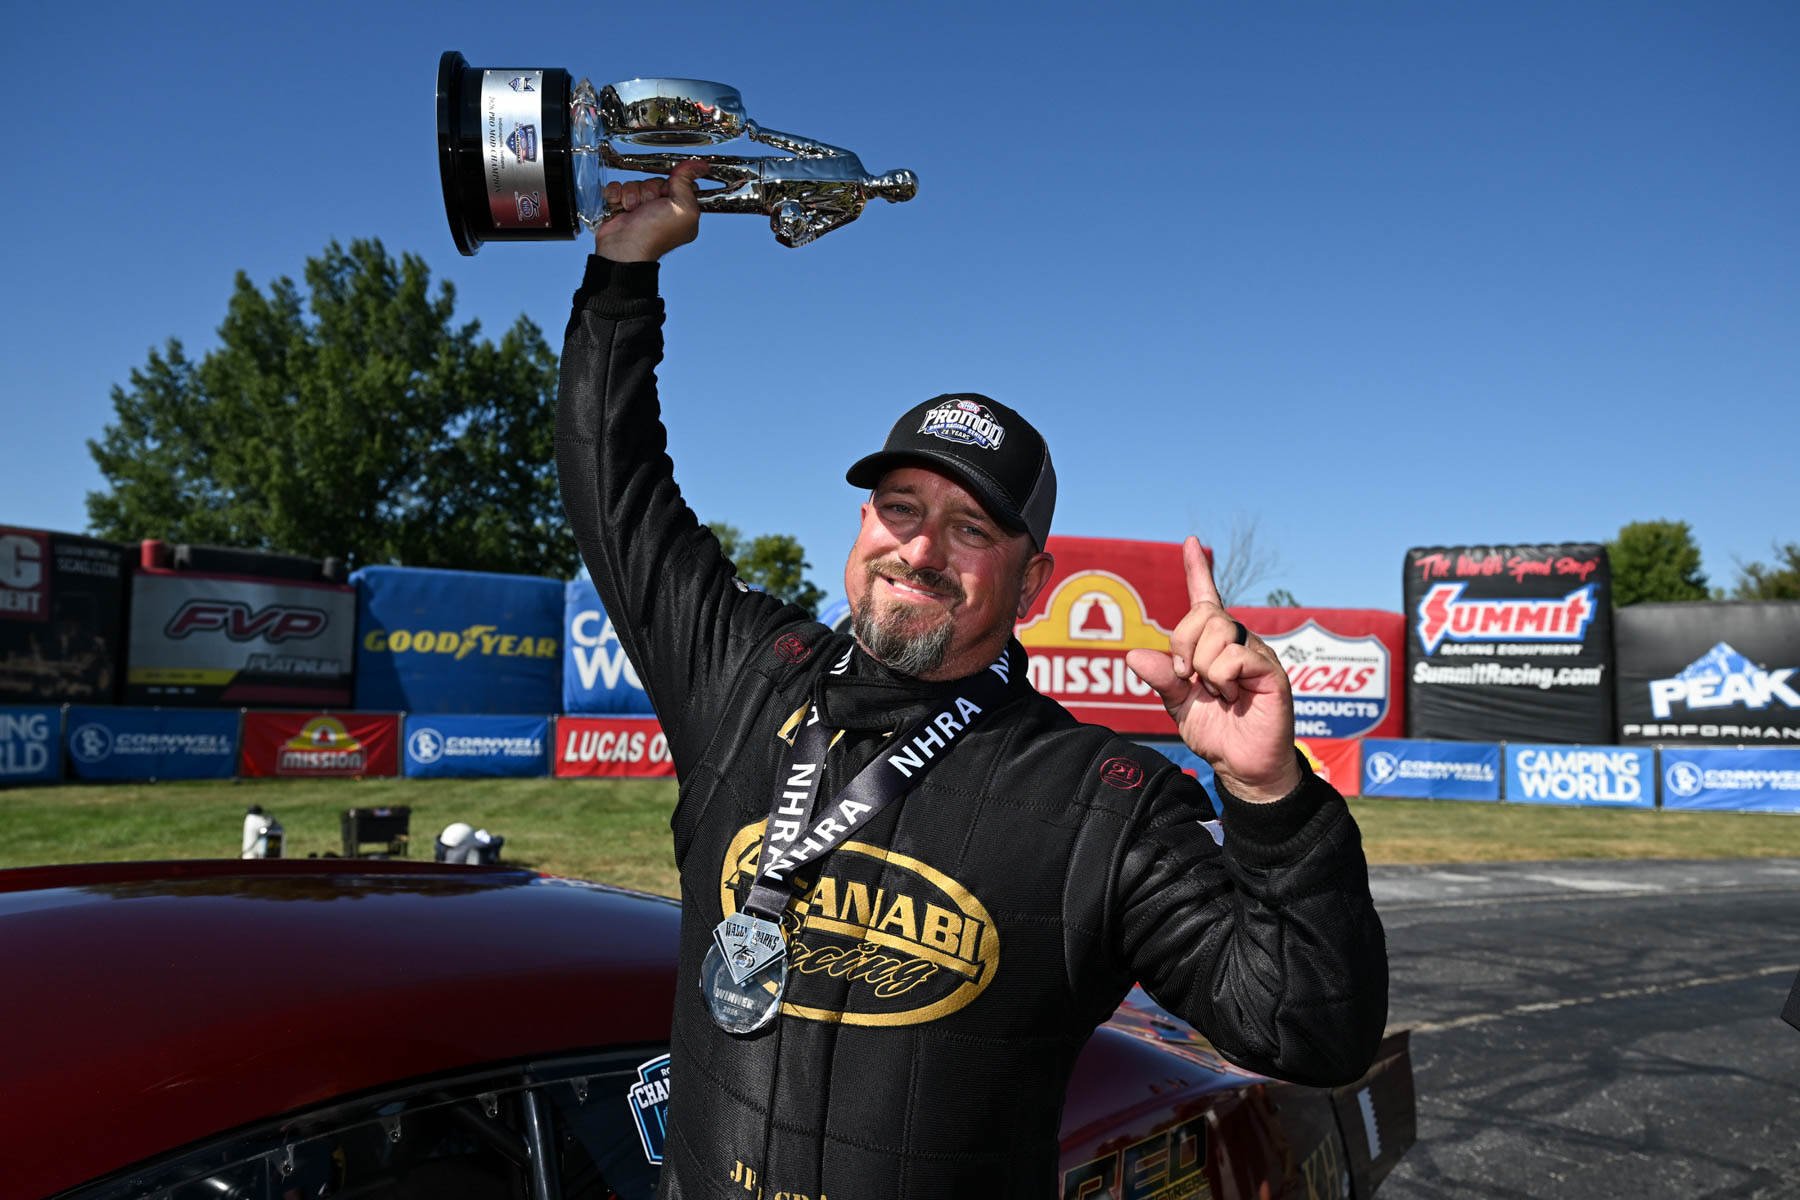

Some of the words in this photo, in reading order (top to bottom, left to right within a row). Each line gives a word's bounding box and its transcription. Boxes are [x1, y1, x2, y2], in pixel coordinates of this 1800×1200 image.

[488, 111, 497, 127] PRO
[489, 129, 499, 149] MOD
[489, 150, 502, 193] CHAMPION
[166, 600, 326, 641] FVP
[1028, 655, 1160, 696] MISSIO
[1285, 666, 1376, 693] UCAS
[1413, 661, 1602, 689] SummitRacing.com
[1649, 667, 1800, 719] PEAK
[1294, 700, 1380, 718] RODUCTS
[564, 731, 646, 763] LUCAS
[888, 696, 983, 778] NHRA
[1516, 750, 1640, 776] CAMPING
[1518, 772, 1642, 801] WORLD
[764, 763, 817, 873] NHRA
[764, 799, 873, 881] NHRA
[715, 987, 755, 1011] WINNER
